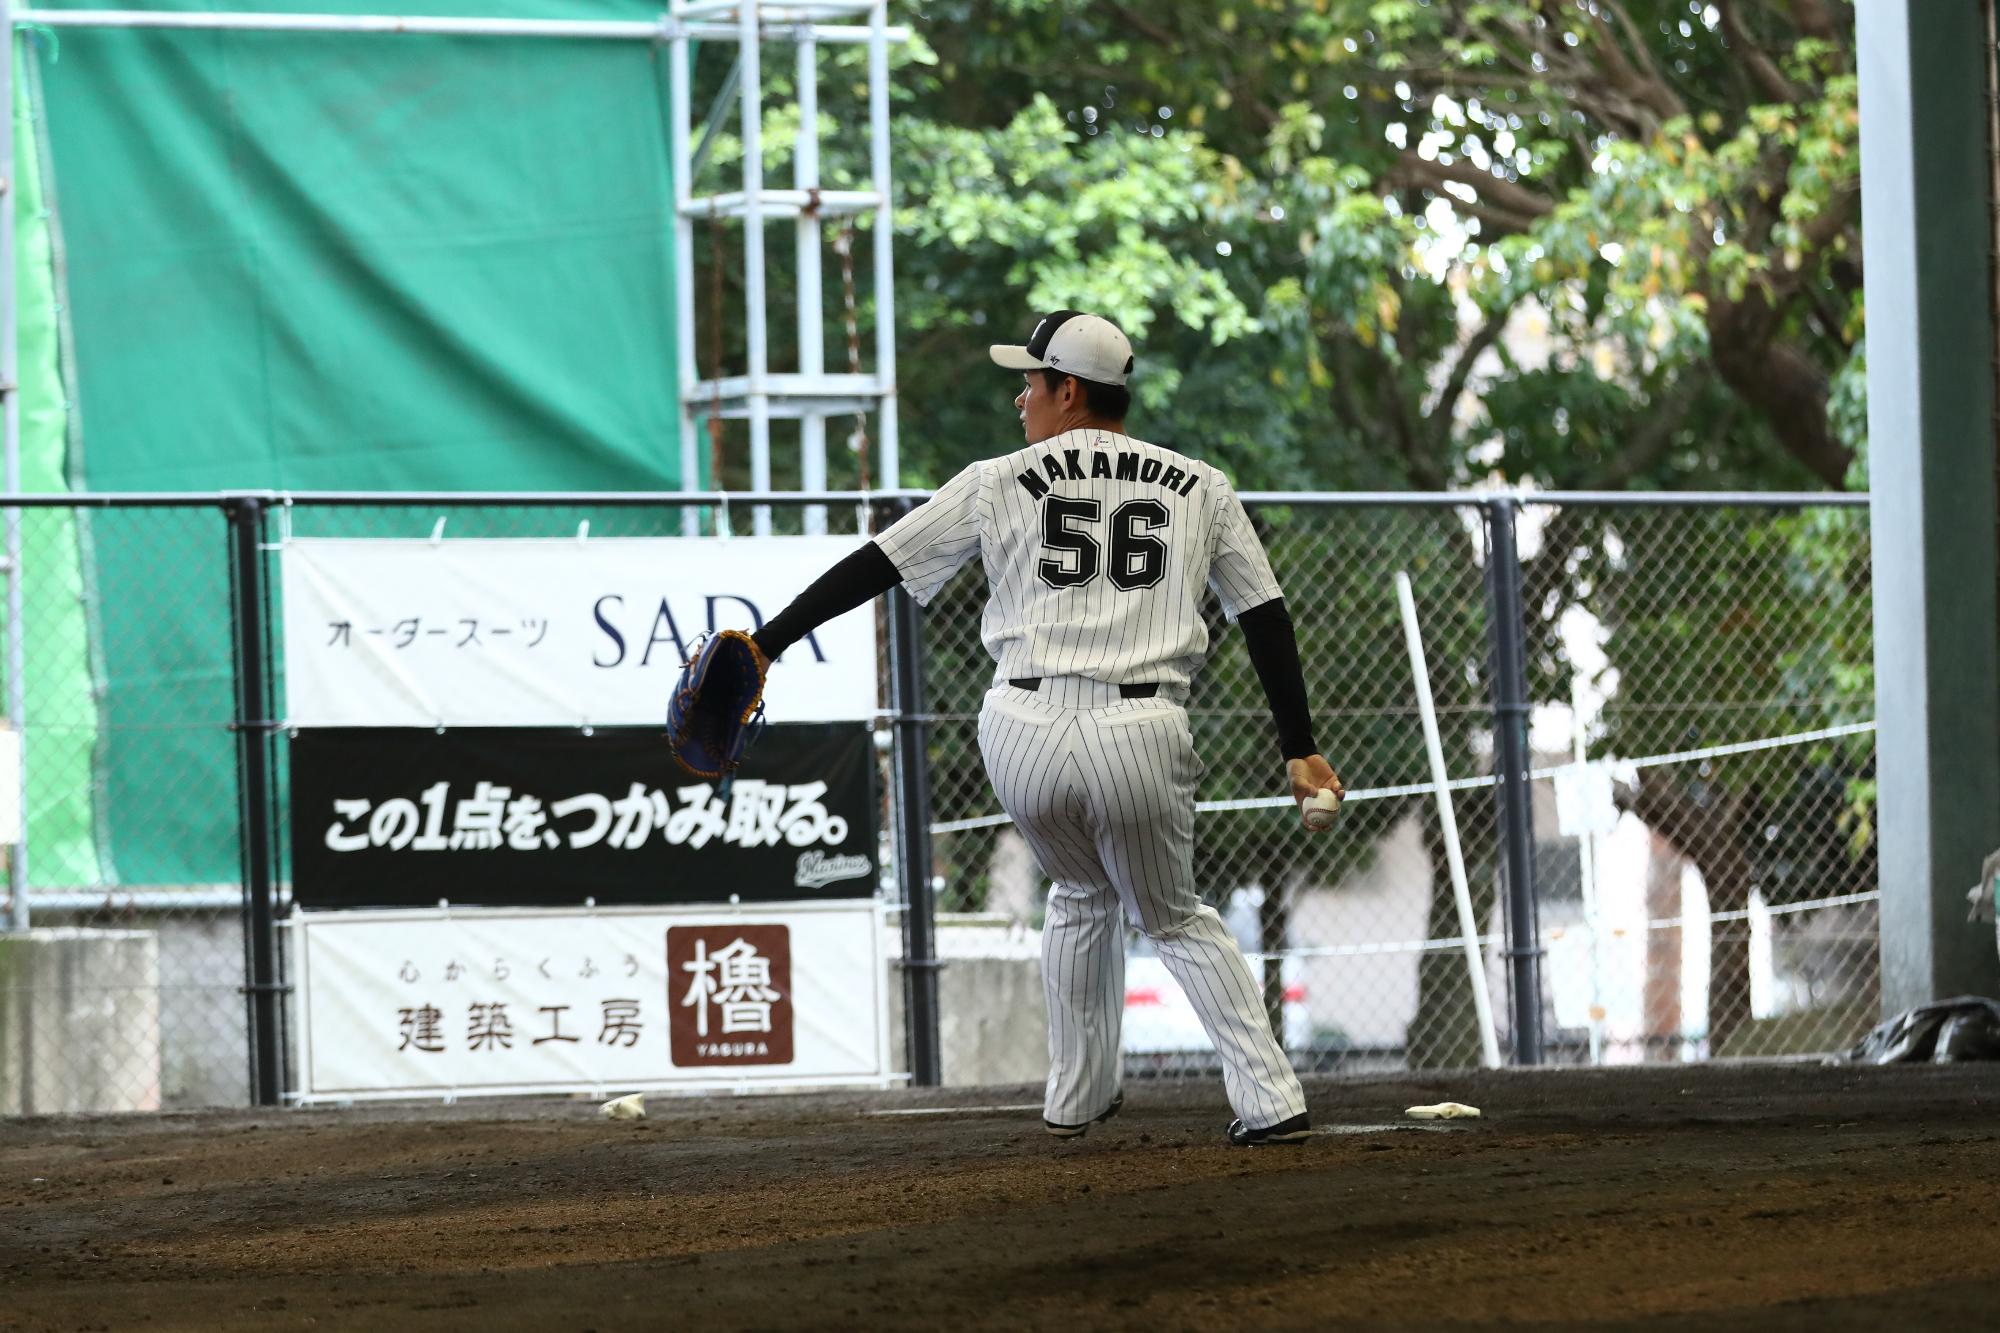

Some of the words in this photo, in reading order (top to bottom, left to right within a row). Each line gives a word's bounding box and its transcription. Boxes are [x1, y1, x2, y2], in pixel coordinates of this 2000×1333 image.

[1017, 449, 1200, 501] NAKAMORI
[1038, 494, 1170, 592] 56
[327, 615, 549, 649] オーダースーツ
[592, 594, 828, 668] SAD
[325, 779, 849, 852] この1点を、つかみ取る。
[399, 953, 641, 984] 心からくふう
[680, 936, 782, 1038] 櫓
[398, 998, 644, 1052] 建築工房
[696, 1041, 770, 1058] YAGURA
